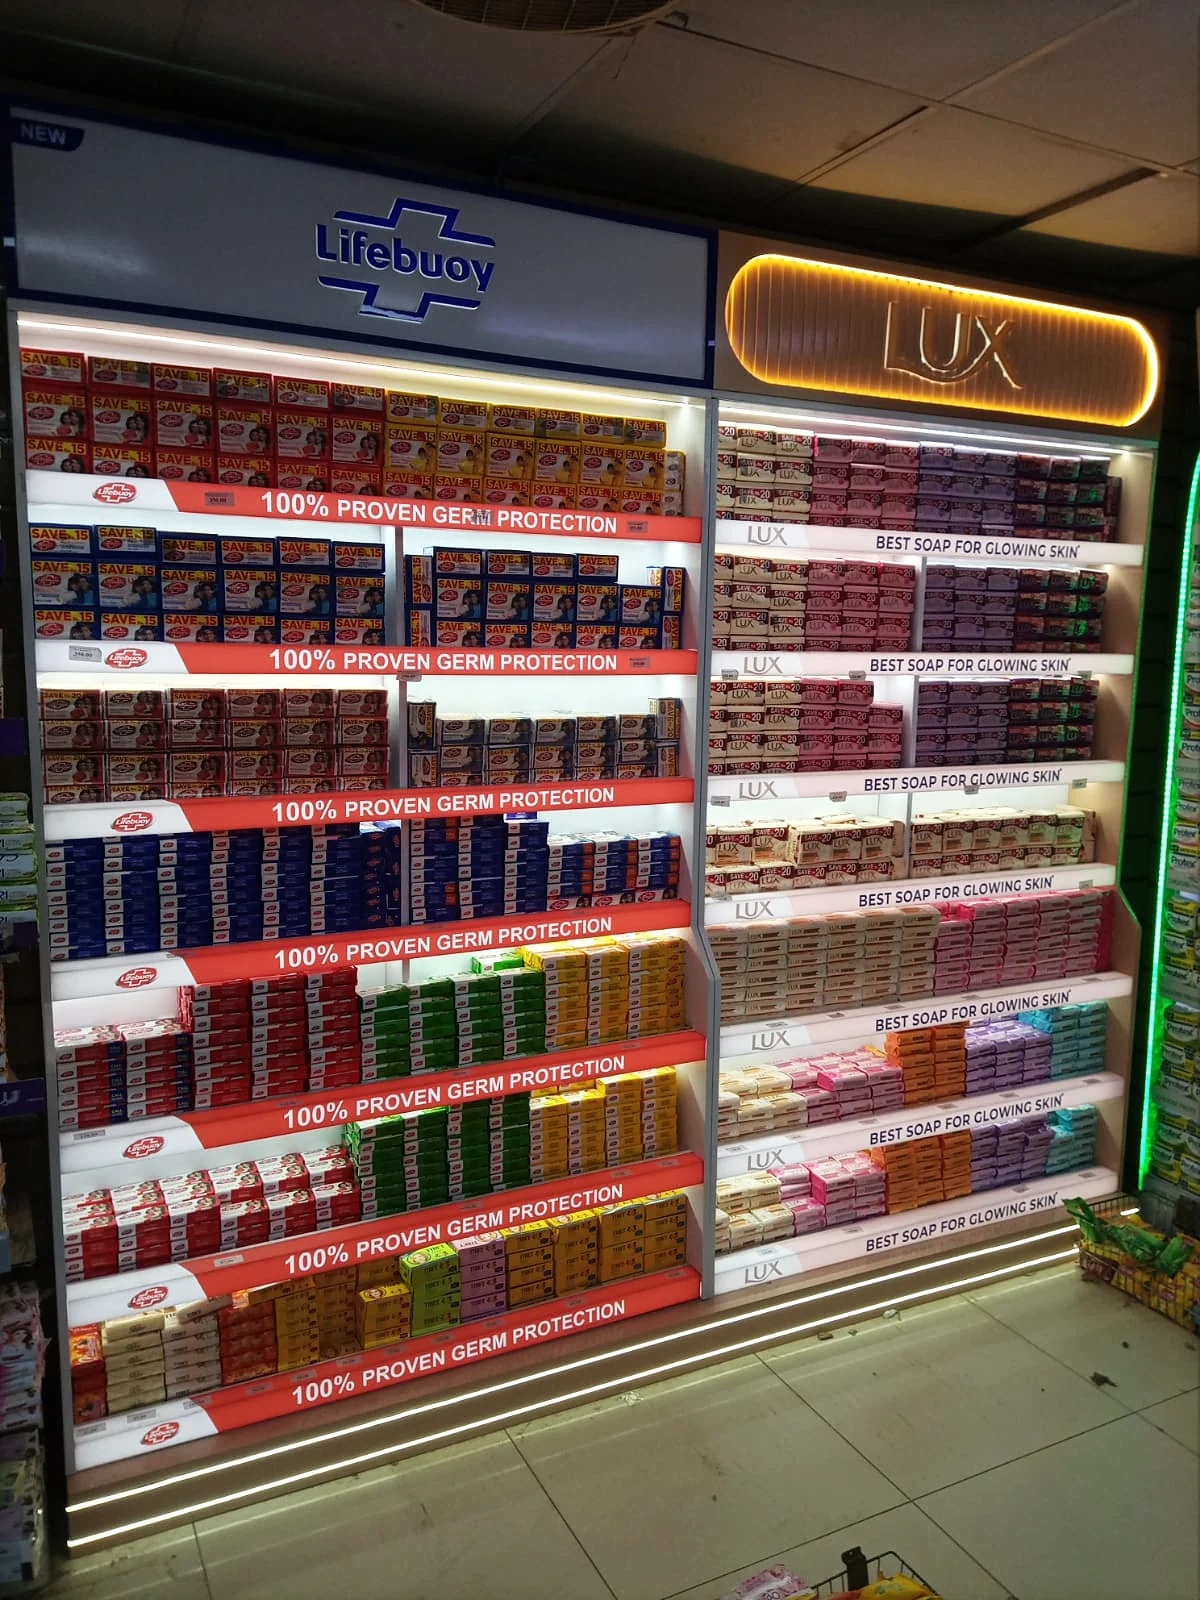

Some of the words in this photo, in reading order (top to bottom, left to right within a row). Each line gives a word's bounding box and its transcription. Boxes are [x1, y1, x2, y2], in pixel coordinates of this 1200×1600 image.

[21, 123, 66, 145] NEW
[315, 224, 495, 291] Lifebuoy
[883, 301, 1022, 390] LUX
[262, 492, 328, 516] 100%
[338, 500, 425, 522] PROVEN
[433, 506, 491, 526] GERM
[498, 510, 616, 533] PROTECTION
[749, 526, 786, 545] LUX
[877, 536, 910, 550] BEST
[915, 538, 951, 552] SOAP
[956, 540, 981, 553] FOR
[986, 542, 1045, 557] GLOWING
[270, 649, 335, 670] 100%
[344, 653, 430, 670] PROVEN
[437, 654, 494, 670] GERM
[501, 654, 616, 670] PROTECTION
[744, 657, 782, 676] LUX
[871, 659, 904, 671] BEST
[908, 659, 943, 671] SOAP
[948, 659, 973, 671] FOR
[978, 659, 1037, 671] GLOWING
[740, 782, 777, 800] LUX
[865, 778, 897, 791] BEST
[902, 776, 936, 789] SOAP
[942, 775, 966, 787] FOR
[971, 772, 1029, 786] GLOWING
[273, 800, 336, 821] 100%
[346, 797, 430, 817] PROVEN
[437, 794, 493, 811] GERM
[500, 787, 614, 808] PROTECTION
[859, 892, 892, 907] BEST
[896, 889, 930, 903] SOAP
[935, 886, 959, 899] FOR
[964, 880, 1021, 896] GLOWING
[736, 901, 773, 919] LUX
[275, 944, 338, 968] 100%
[347, 937, 430, 960] PROVEN
[437, 930, 492, 950] GERM
[499, 917, 611, 943] PROTECTION
[876, 1015, 908, 1031] BEST
[913, 1010, 947, 1026] SOAP
[952, 1005, 976, 1019] FOR
[981, 996, 1038, 1016] GLOWING
[752, 1031, 790, 1050] LUX
[284, 1101, 347, 1128] 100%
[357, 1087, 440, 1115] PROVEN
[448, 1076, 503, 1099] GERM
[510, 1056, 625, 1088] PROTECTION
[871, 1128, 902, 1145] BEST
[907, 1120, 941, 1137] SOAP
[946, 1114, 970, 1129] FOR
[974, 1102, 1032, 1124] GLOWING
[748, 1150, 785, 1172] LUX
[285, 1244, 348, 1273] 100%
[357, 1224, 440, 1258] PROVEN
[448, 1210, 502, 1236] GERM
[510, 1184, 623, 1222] PROTECTION
[867, 1233, 898, 1251] BEST
[902, 1224, 937, 1242] SOAP
[941, 1217, 965, 1232] FOR
[969, 1202, 1026, 1226] GLOWING
[745, 1261, 782, 1283] LUX
[293, 1373, 354, 1404] 100%
[363, 1350, 445, 1386] PROVEN
[452, 1332, 506, 1360] GERM
[513, 1300, 624, 1344] PROTECTION
